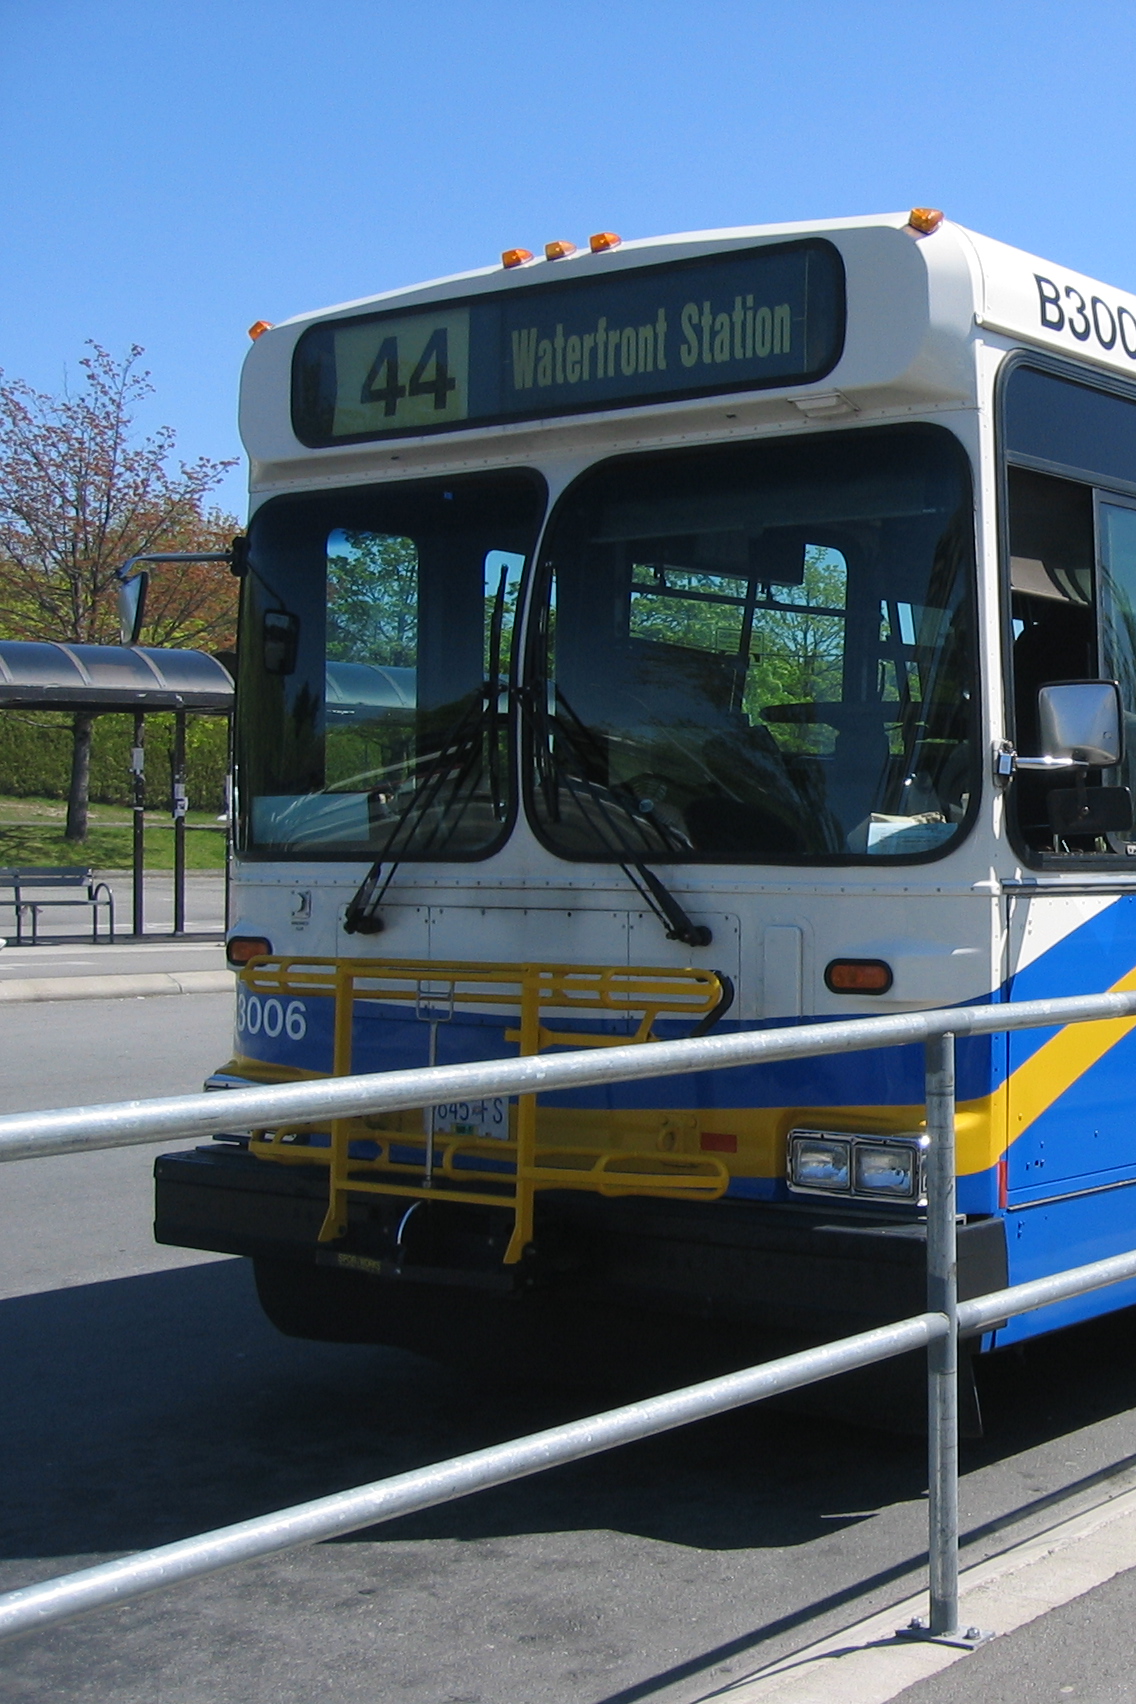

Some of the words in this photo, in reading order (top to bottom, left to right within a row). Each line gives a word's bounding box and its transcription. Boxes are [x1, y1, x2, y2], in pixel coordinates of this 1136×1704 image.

[359, 327, 456, 418] 44
[511, 307, 668, 391] Waterfront
[680, 294, 792, 368] Station
[237, 993, 307, 1041] 3006
